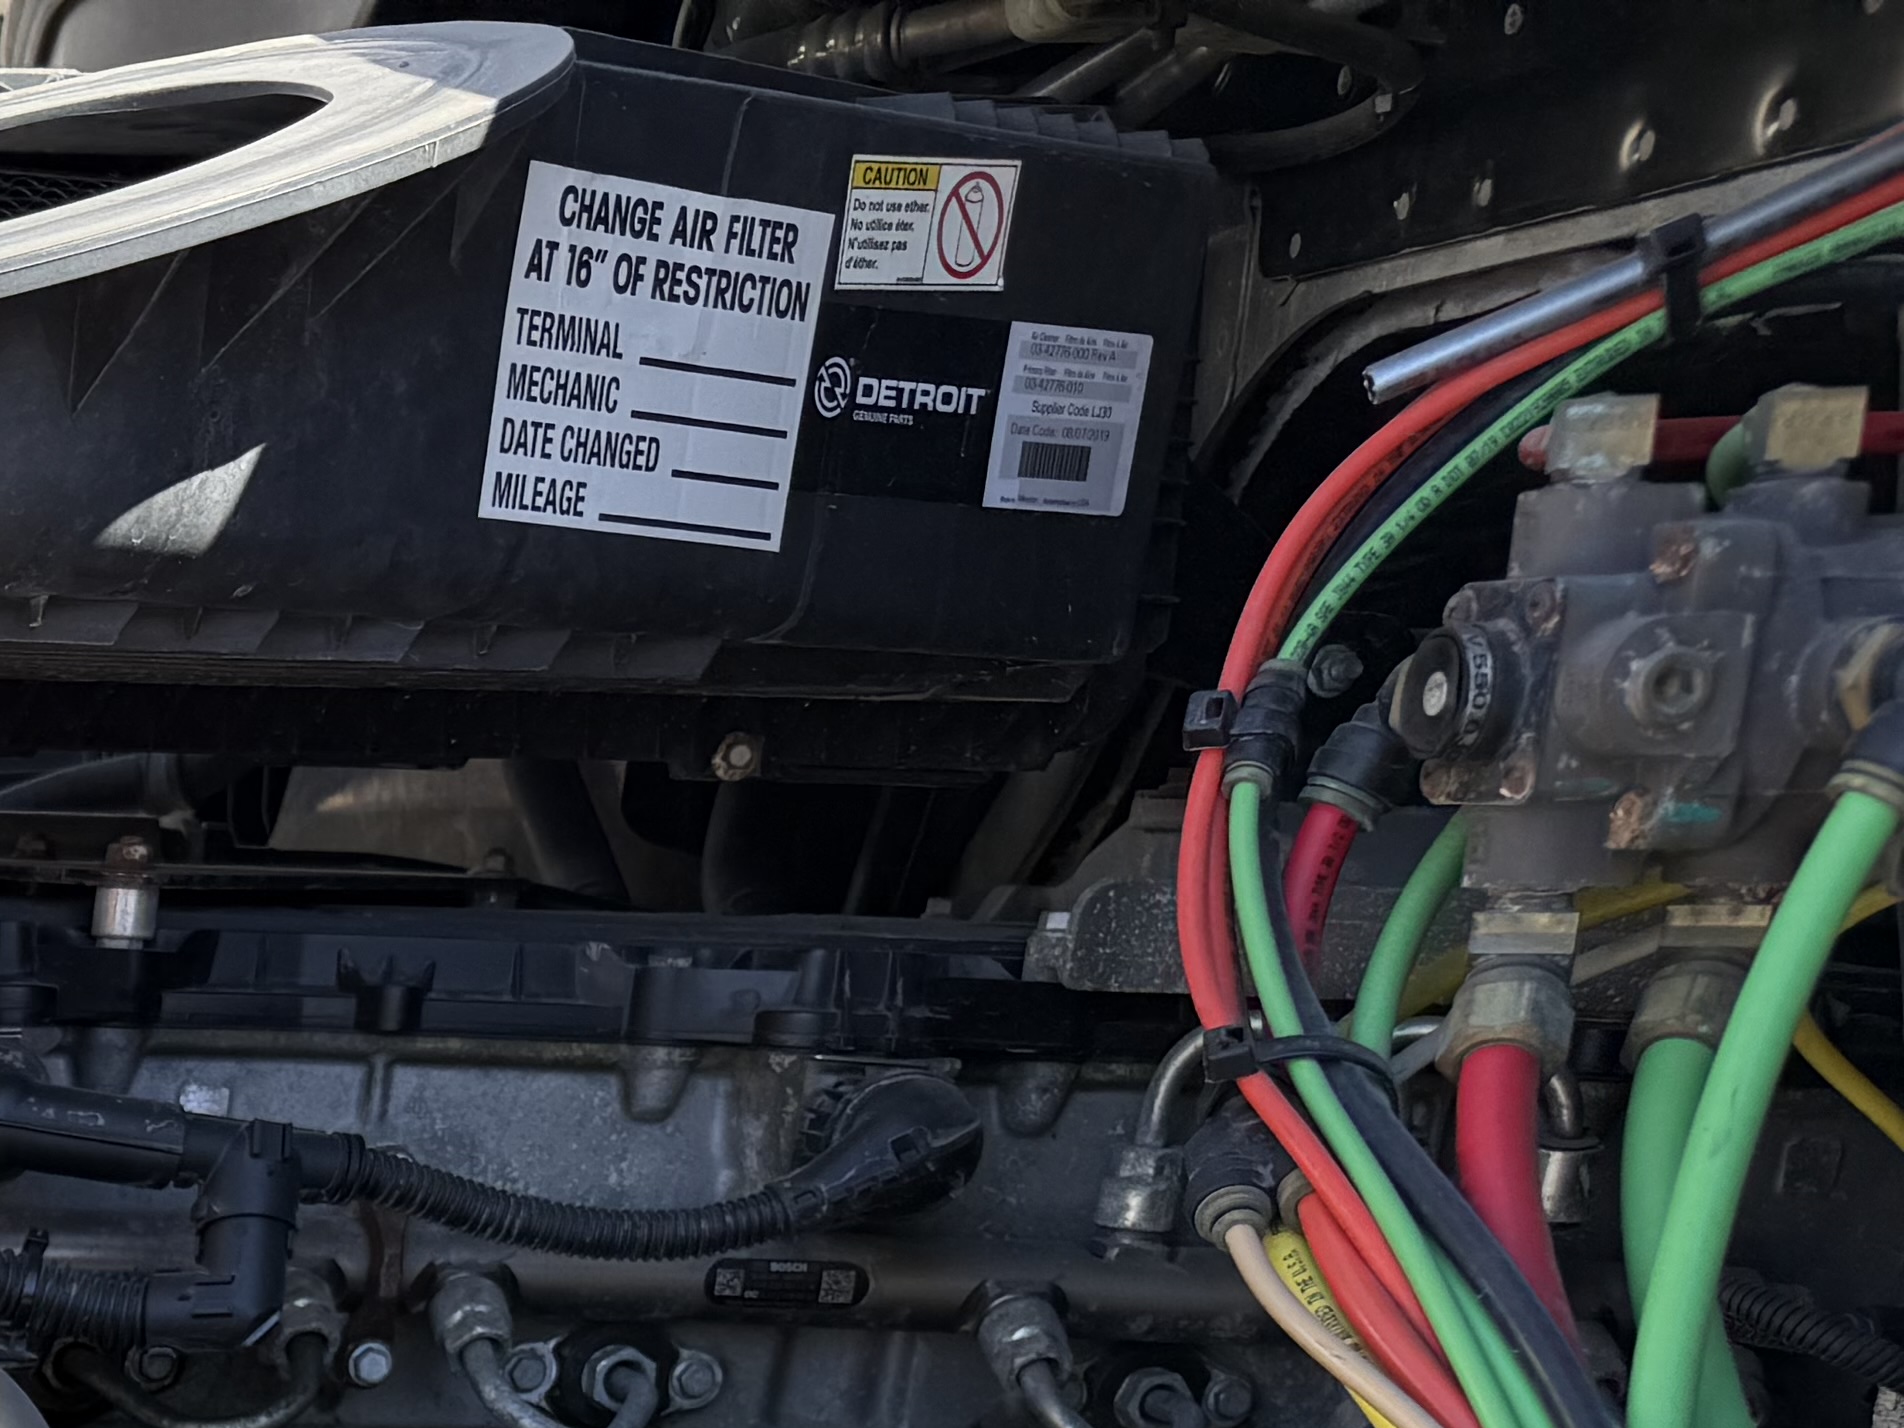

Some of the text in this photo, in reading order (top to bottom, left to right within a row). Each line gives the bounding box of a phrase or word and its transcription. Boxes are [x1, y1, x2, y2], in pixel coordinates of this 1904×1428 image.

[863, 166, 929, 186] CAUTION
[559, 185, 799, 264] CHANGE AIR FILTER
[853, 199, 902, 212] Do not use
[850, 219, 862, 231] No
[891, 240, 907, 253] pas
[524, 239, 810, 322] AT 16" OF RESTRICTION
[516, 307, 623, 360] TERMINAL
[506, 362, 620, 414] MECHANIC
[855, 377, 986, 415] DETROIT
[1031, 400, 1089, 417] Supplier Code
[500, 417, 660, 472] DATE CHANGED
[1010, 422, 1030, 436] Date
[492, 471, 587, 517] MILEAGE
